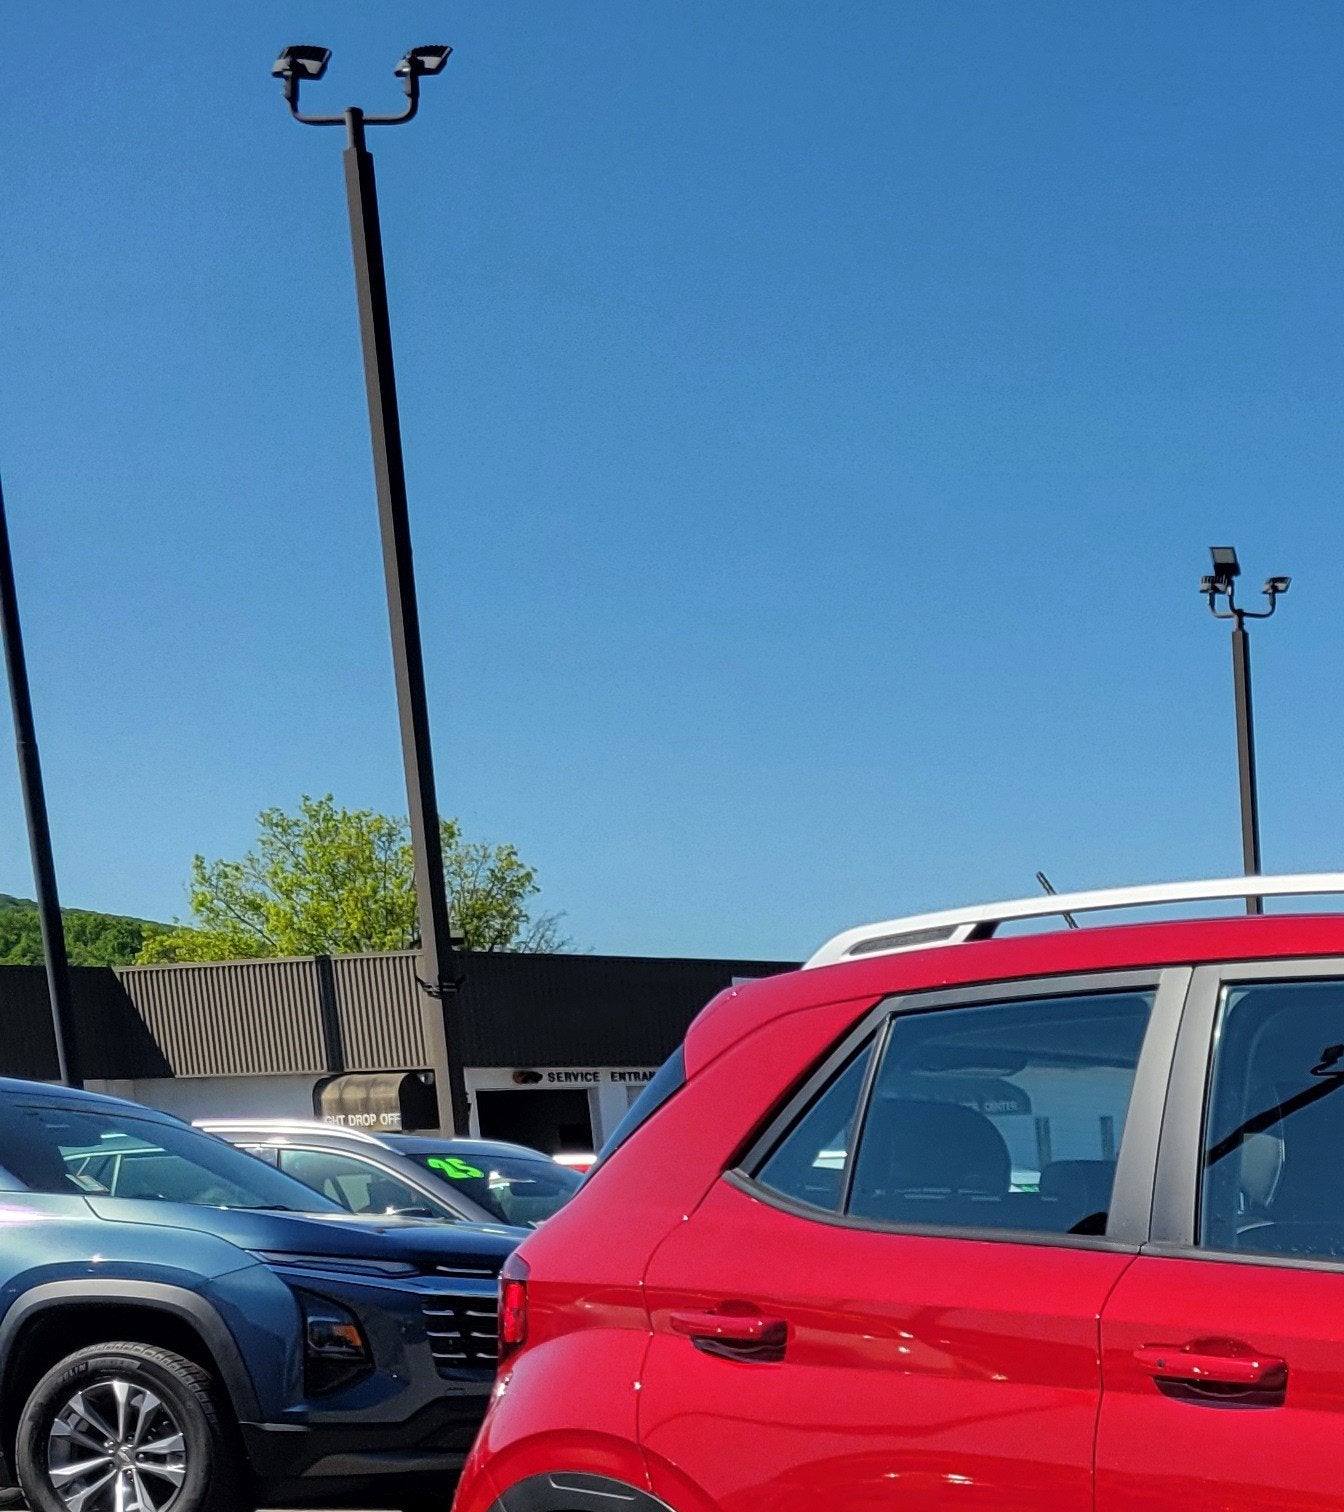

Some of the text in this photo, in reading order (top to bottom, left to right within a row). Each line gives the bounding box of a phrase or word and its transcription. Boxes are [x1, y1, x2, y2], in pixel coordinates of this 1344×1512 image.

[547, 1071, 657, 1083] SERVICE ENTRAN
[326, 1113, 400, 1127] GHT DROP OFF
[427, 1158, 485, 1180] 25
